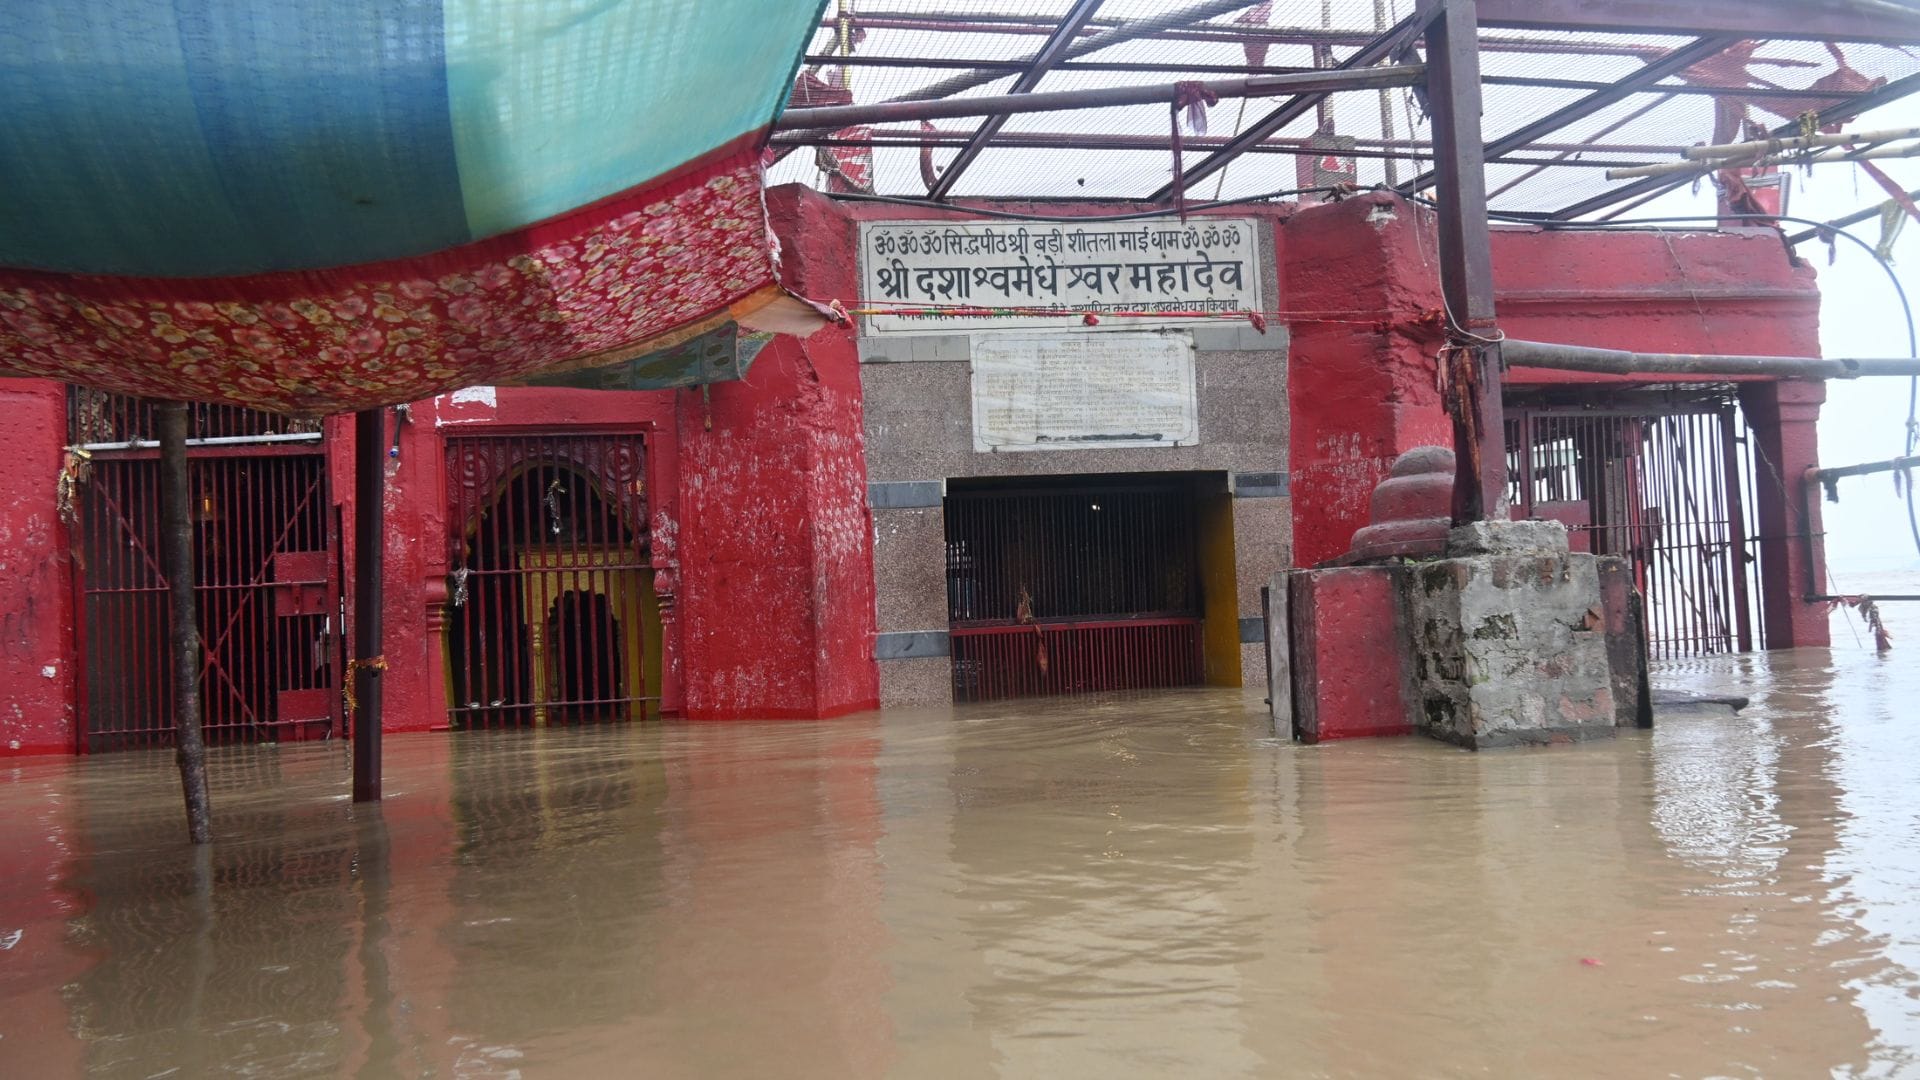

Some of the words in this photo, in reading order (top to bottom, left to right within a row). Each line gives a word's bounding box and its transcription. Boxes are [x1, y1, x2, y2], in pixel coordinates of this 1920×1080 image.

[875, 230, 895, 255] ॐ
[897, 230, 918, 255] ॐ
[920, 230, 941, 255] ॐ
[1008, 227, 1029, 254] श्री
[1066, 229, 1116, 252] शीतला
[1117, 227, 1149, 253] माई
[1151, 230, 1182, 250] धाम
[1182, 225, 1200, 249] ॐ
[1202, 224, 1220, 249] ॐ
[1222, 224, 1240, 248] ॐ
[877, 258, 909, 299] श्री
[1125, 250, 1243, 295] महादेव
